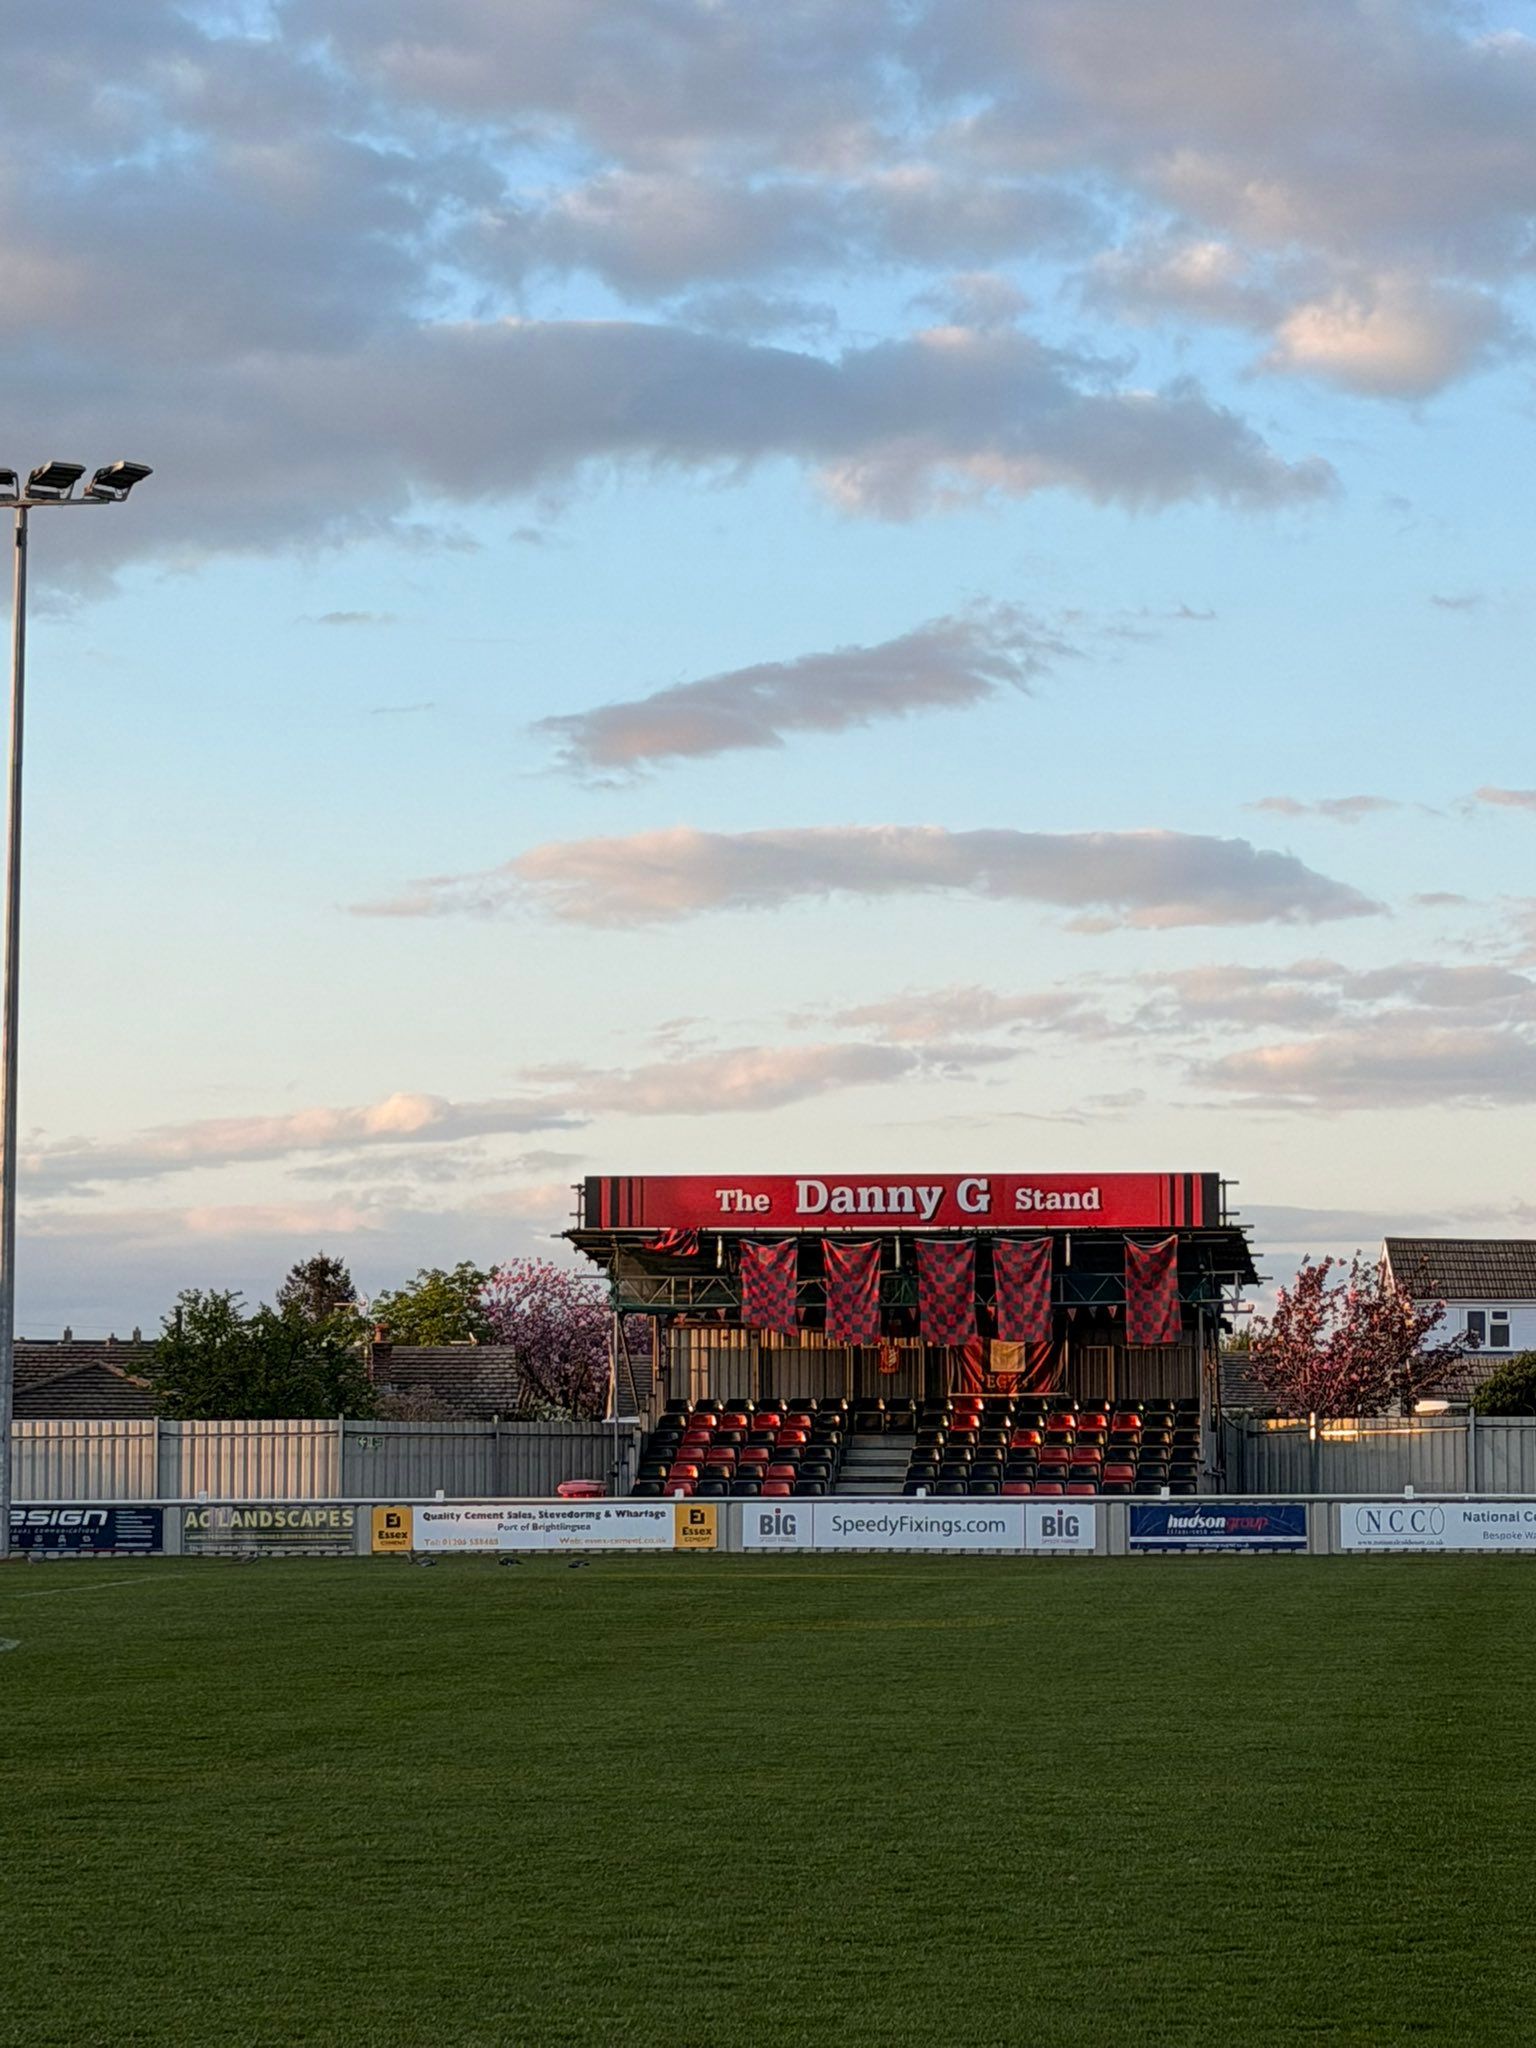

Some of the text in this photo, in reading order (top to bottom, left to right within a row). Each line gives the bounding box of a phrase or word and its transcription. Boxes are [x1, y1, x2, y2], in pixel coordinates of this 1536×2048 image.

[715, 1178, 1101, 1220] The Danny G Stand
[184, 1510, 354, 1528] AC LANDSCAPES
[423, 1509, 666, 1522] Quality Cement Sales, Stevedoring & Wharfage
[1463, 1510, 1520, 1523] National
[497, 1522, 592, 1533] Port of Brightlingsea
[682, 1526, 712, 1536] Essex
[832, 1515, 1006, 1537] SpeedyFixings.com
[378, 1530, 408, 1540] Essex
[1483, 1530, 1523, 1541] Bespoke
